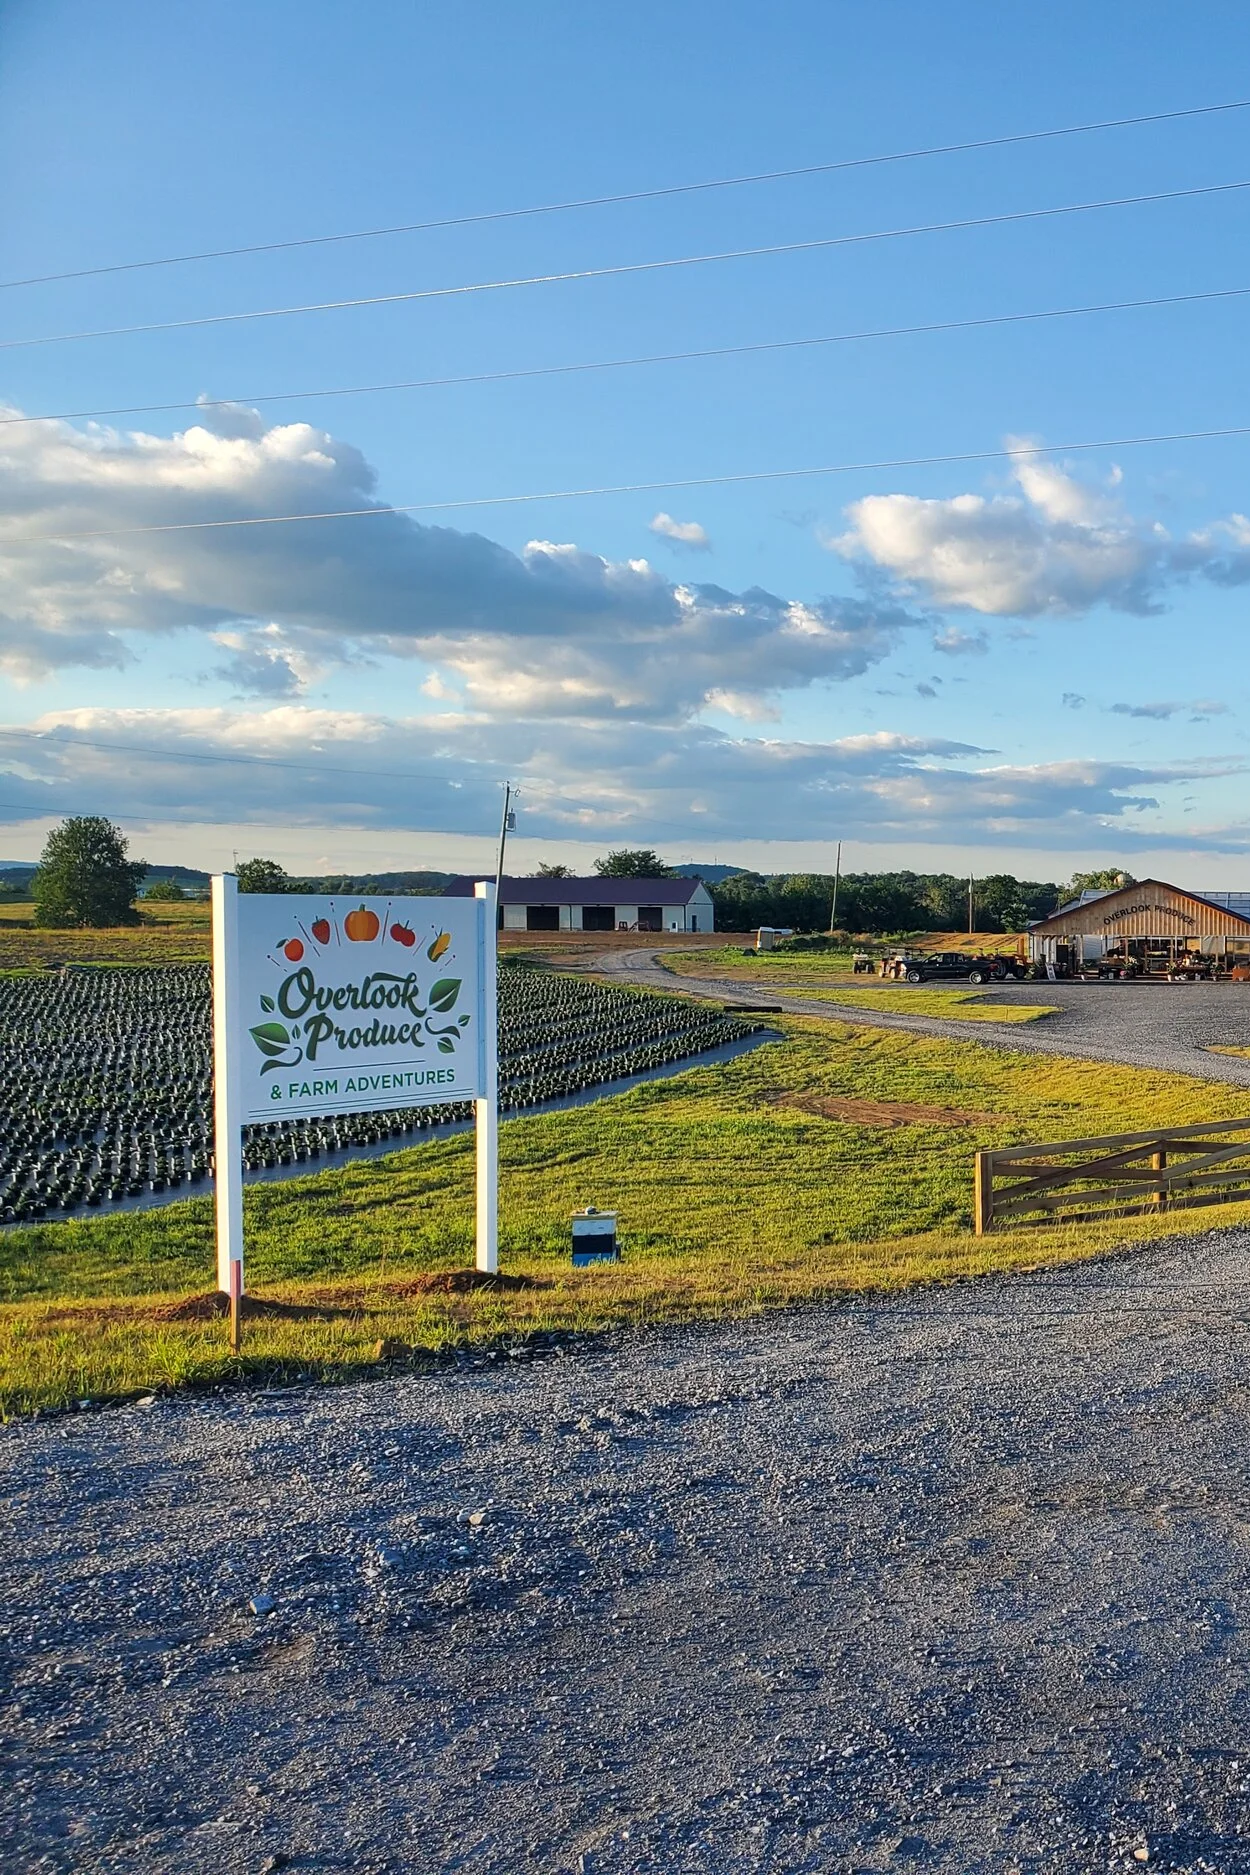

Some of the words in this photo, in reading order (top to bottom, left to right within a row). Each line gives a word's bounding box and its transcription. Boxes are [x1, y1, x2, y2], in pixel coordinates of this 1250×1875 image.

[1103, 904, 1151, 925] OVERLOOK
[1154, 905, 1195, 926] PRODUCE
[278, 967, 427, 1019] Overlook
[304, 1013, 425, 1061] Produce
[270, 1085, 282, 1099] &
[289, 1080, 338, 1098] FARM
[345, 1069, 455, 1092] ADVENTURES
